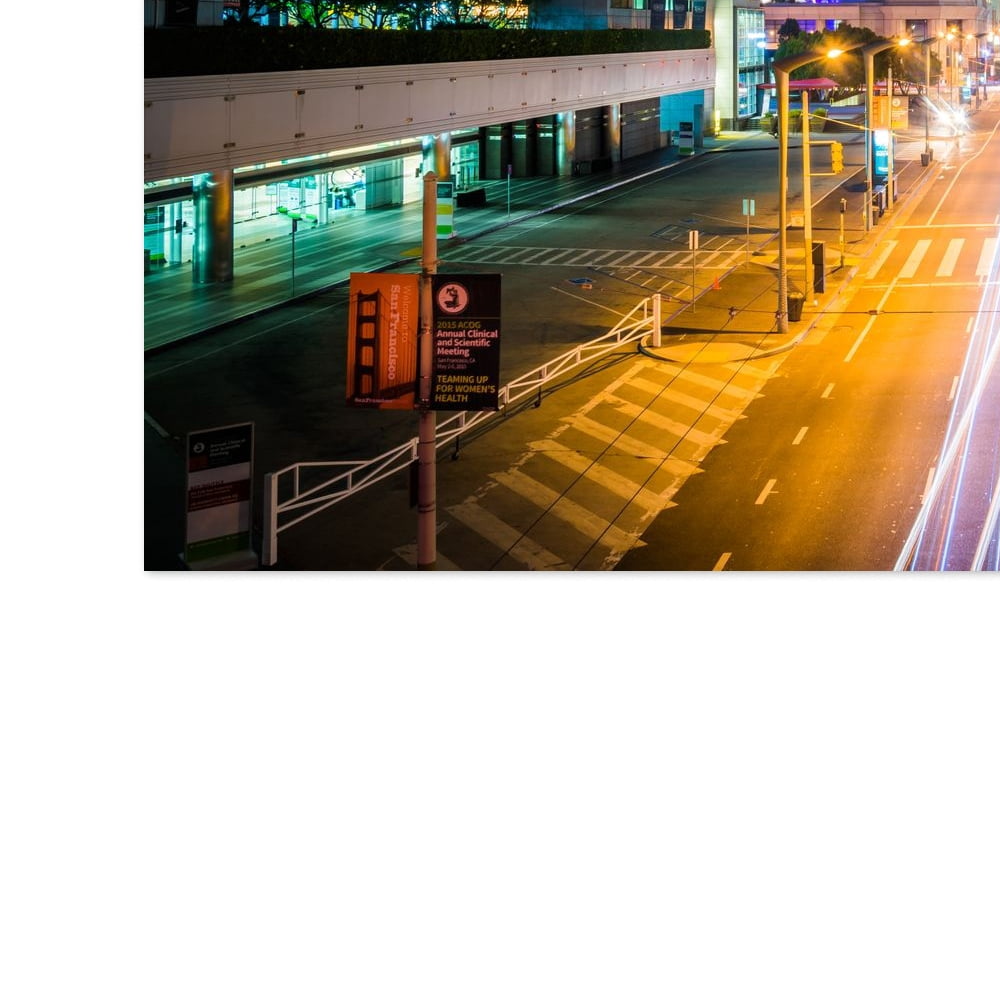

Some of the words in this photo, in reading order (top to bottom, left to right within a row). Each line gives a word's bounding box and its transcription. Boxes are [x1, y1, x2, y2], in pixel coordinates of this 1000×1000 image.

[390, 284, 400, 310] San
[437, 321, 457, 329] 2015
[458, 321, 481, 329] ACOG
[436, 329, 466, 338] Annual
[467, 329, 498, 338] Clinical
[387, 311, 400, 380] Francisco
[437, 338, 452, 346] and
[454, 338, 491, 347] Scientific
[437, 347, 470, 357] Meeting
[437, 375, 475, 383] TEAMING
[436, 384, 453, 392] FOR
[455, 385, 496, 394] WOMEN'S
[435, 394, 469, 403] HEALTH
